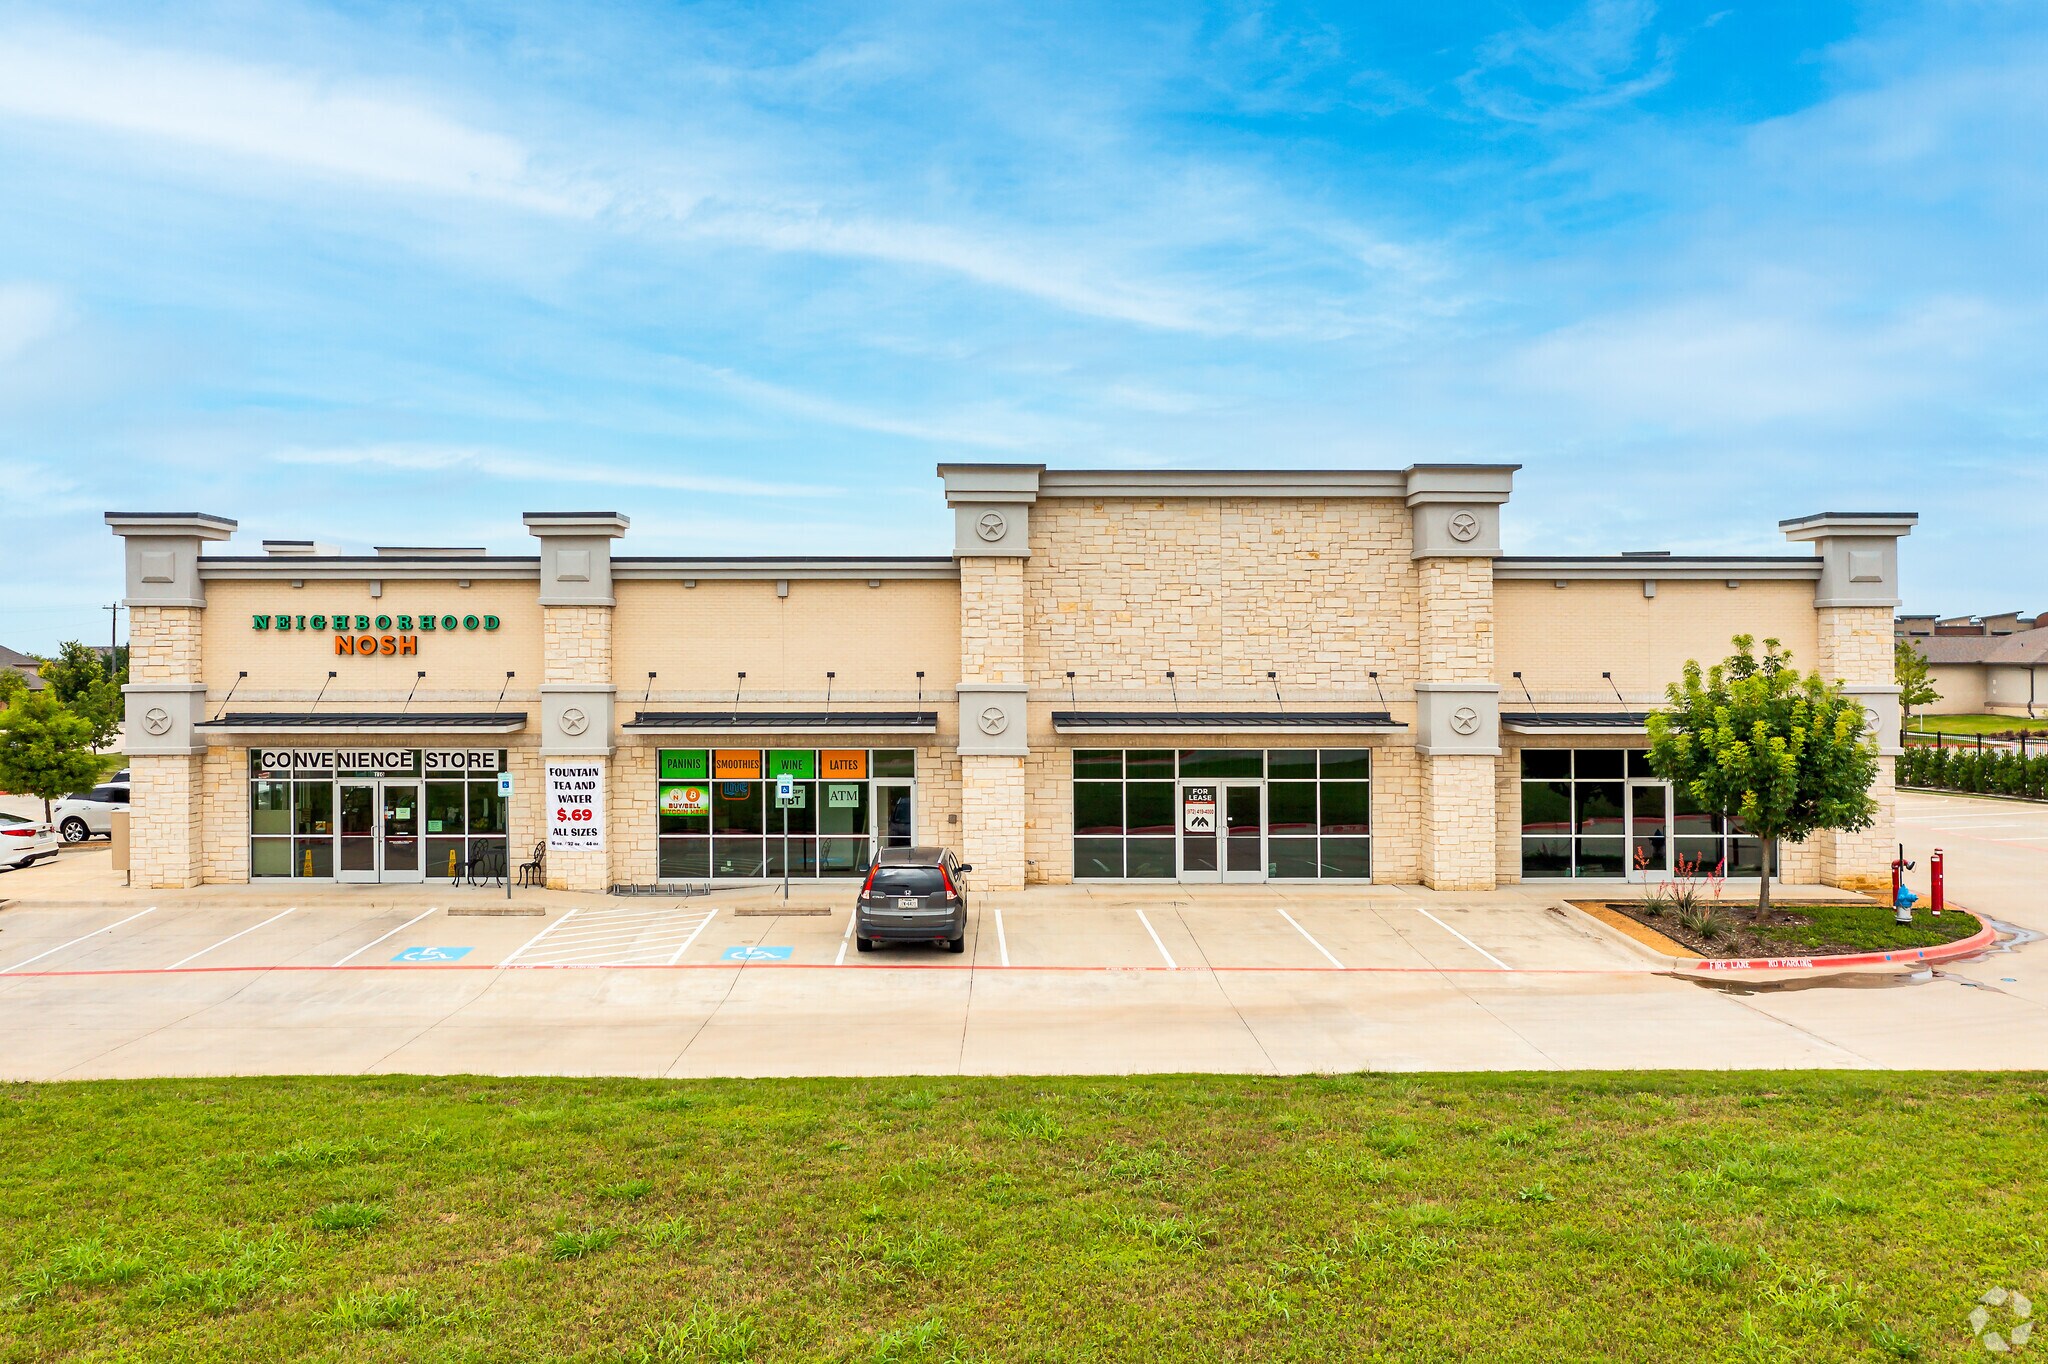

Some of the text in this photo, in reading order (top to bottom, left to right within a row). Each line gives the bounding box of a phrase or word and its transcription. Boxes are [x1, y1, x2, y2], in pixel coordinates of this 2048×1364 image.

[252, 615, 501, 630] NEIGHBORHOOD
[334, 635, 418, 656] NOSH
[262, 752, 495, 768] CONVENIENCE STORE
[667, 758, 701, 769] PANINIS
[716, 760, 760, 769] SMOOTHIES
[781, 760, 803, 770] WINE
[829, 760, 859, 770] LATTES
[549, 768, 599, 777] FOUNTAIN
[553, 781, 596, 790] TEA AND
[557, 794, 592, 804] WATER
[830, 790, 858, 801] ATM
[556, 807, 593, 823] $.69
[552, 827, 598, 837] ALL SIZES
[1709, 959, 1813, 970] FIRE LANE NO PARKING
